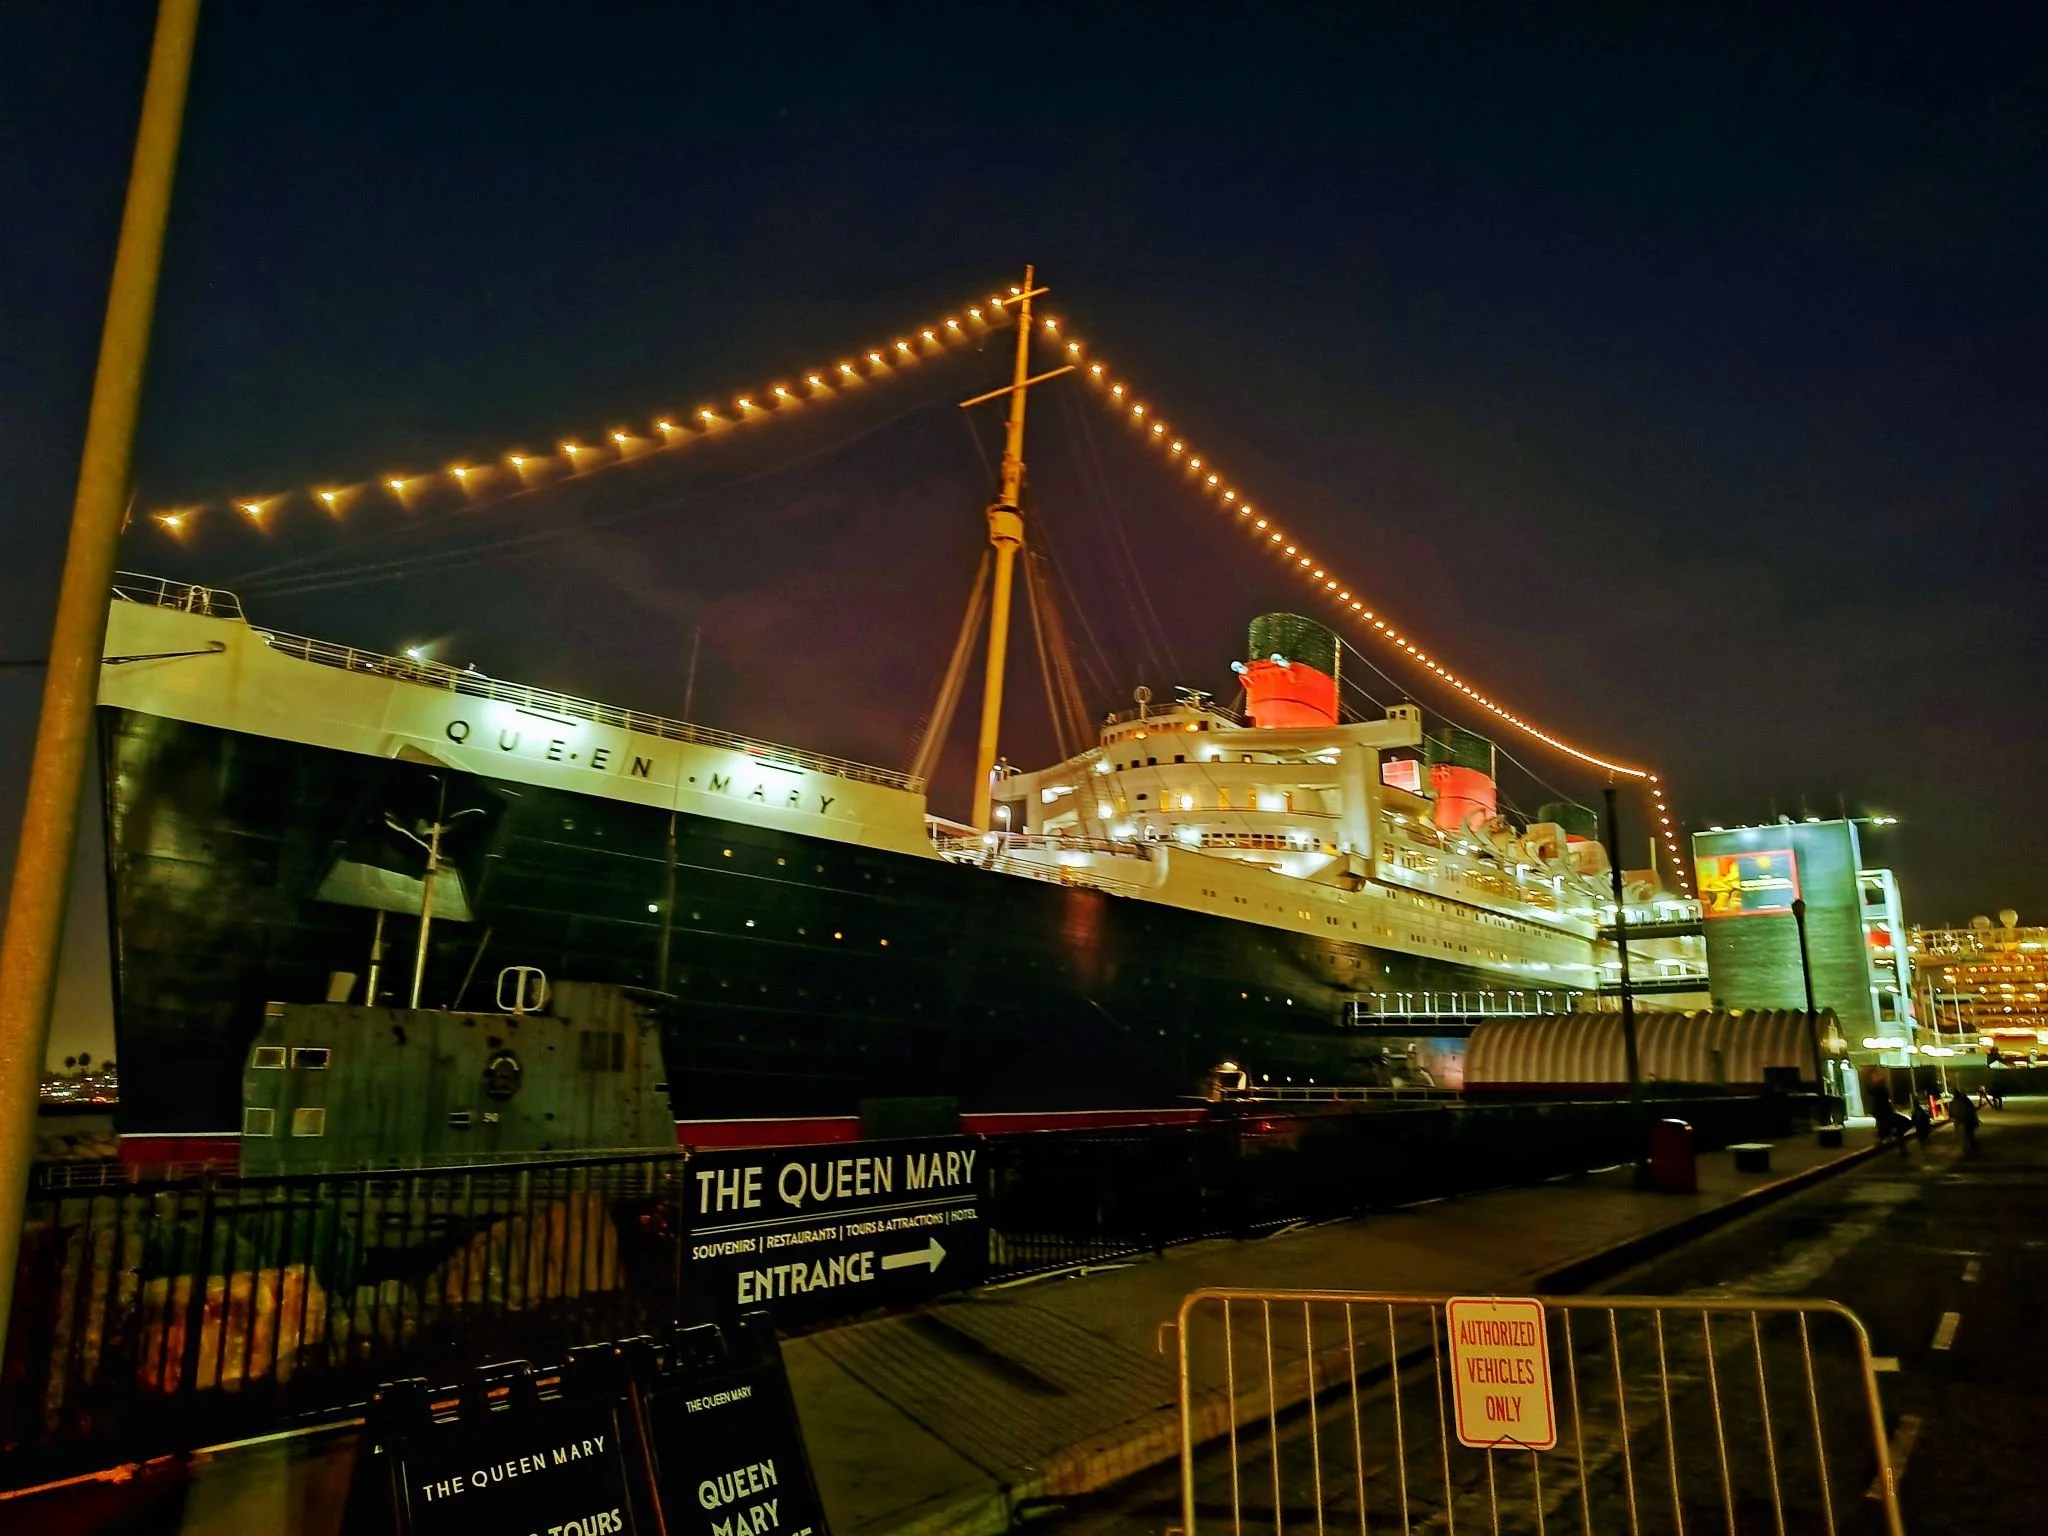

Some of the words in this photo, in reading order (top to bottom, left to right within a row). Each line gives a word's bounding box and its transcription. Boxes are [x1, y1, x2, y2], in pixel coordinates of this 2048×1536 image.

[446, 720, 652, 777] QUEEN
[708, 772, 835, 814] MARY
[696, 1166, 762, 1213] THE
[778, 1156, 892, 1208] QUEEN
[906, 1150, 976, 1189] MARY
[692, 1238, 756, 1260] SOUVENIRS
[766, 1227, 837, 1249] RESTAURANTS
[846, 1221, 877, 1237] TOURS
[886, 1212, 943, 1231] ATTRACTIONS
[951, 1208, 978, 1222] HOTEL
[737, 1252, 874, 1304] ENTRANCE
[1460, 1320, 1535, 1347] AUTHORIZED
[1466, 1358, 1535, 1385] VEHICLES
[685, 1398, 703, 1413] THE
[702, 1391, 731, 1409] QUEEN
[730, 1385, 752, 1401] MARY
[1486, 1395, 1521, 1422] ONLY
[422, 1476, 464, 1502] THE
[471, 1453, 546, 1488] QUEEN
[552, 1436, 605, 1465] MARY
[698, 1459, 778, 1510] QUEEN
[710, 1498, 780, 1536] MARY
